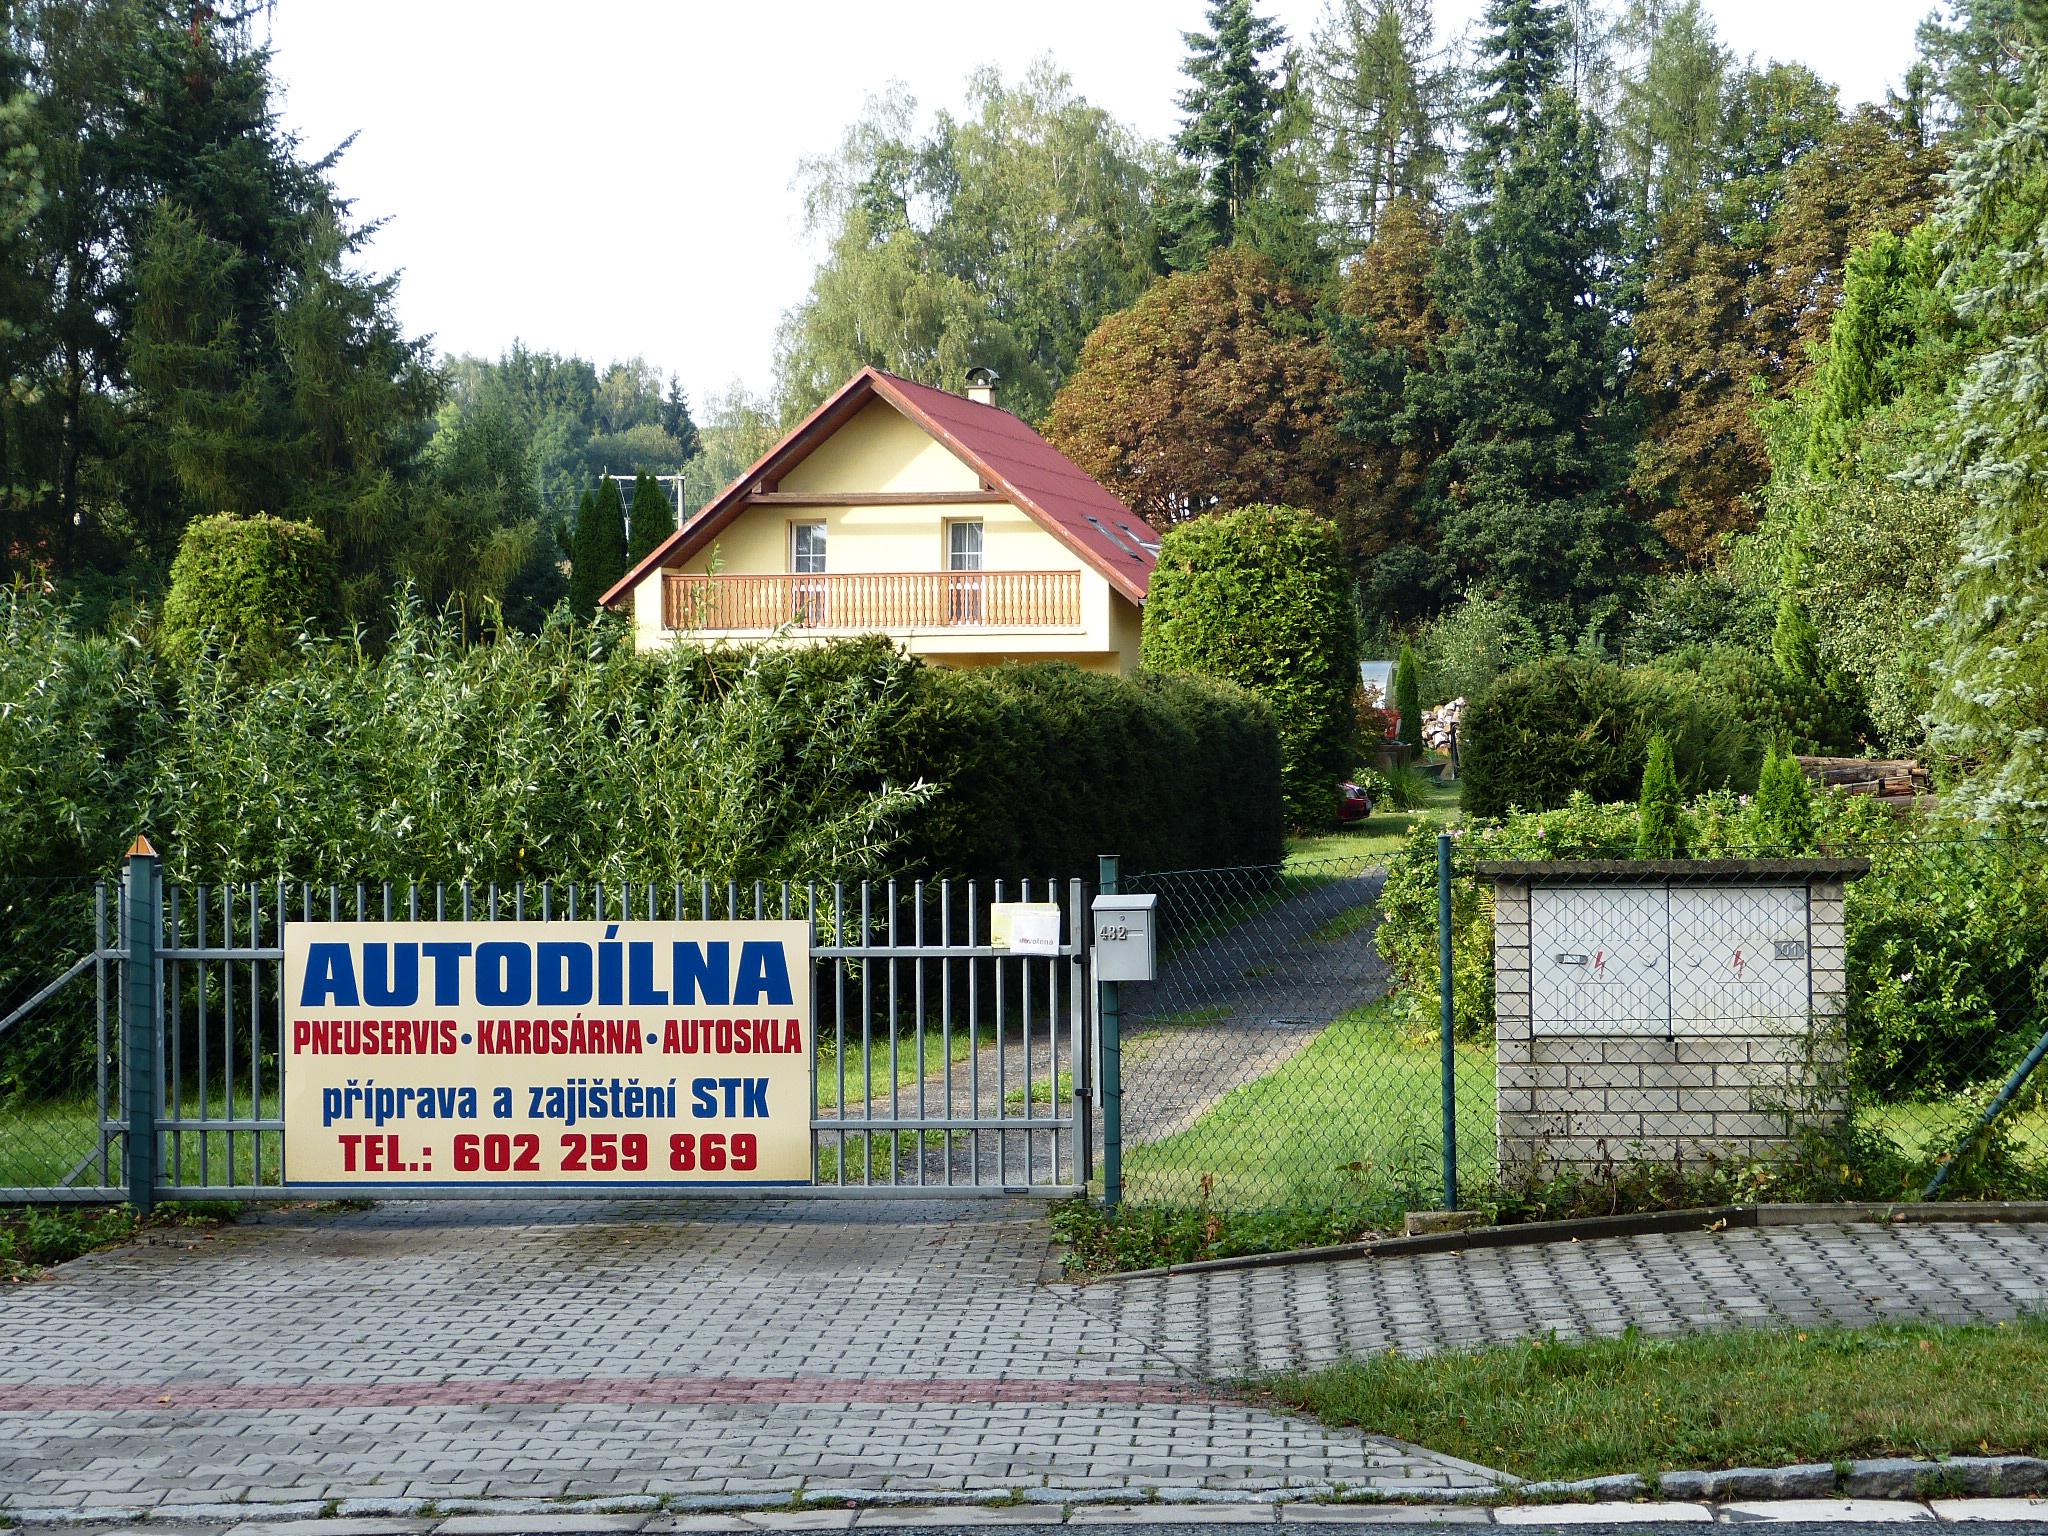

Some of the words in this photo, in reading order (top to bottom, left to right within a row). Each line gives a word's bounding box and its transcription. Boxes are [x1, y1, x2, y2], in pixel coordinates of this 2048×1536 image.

[1100, 926, 1127, 940] 432
[301, 925, 793, 1006] AUTODÍLNA
[294, 1020, 457, 1055] PNEUSERVIS
[477, 1013, 642, 1055] KAROSÁRNA
[663, 1019, 802, 1055] AUTOSKLA
[323, 1079, 477, 1126] příprava
[494, 1087, 512, 1118] a
[529, 1078, 676, 1126] zajištění
[692, 1078, 769, 1118] STK
[339, 1134, 432, 1172] TEL.:
[454, 1134, 539, 1172] 602
[561, 1134, 648, 1172] 259
[670, 1134, 757, 1172] 869
